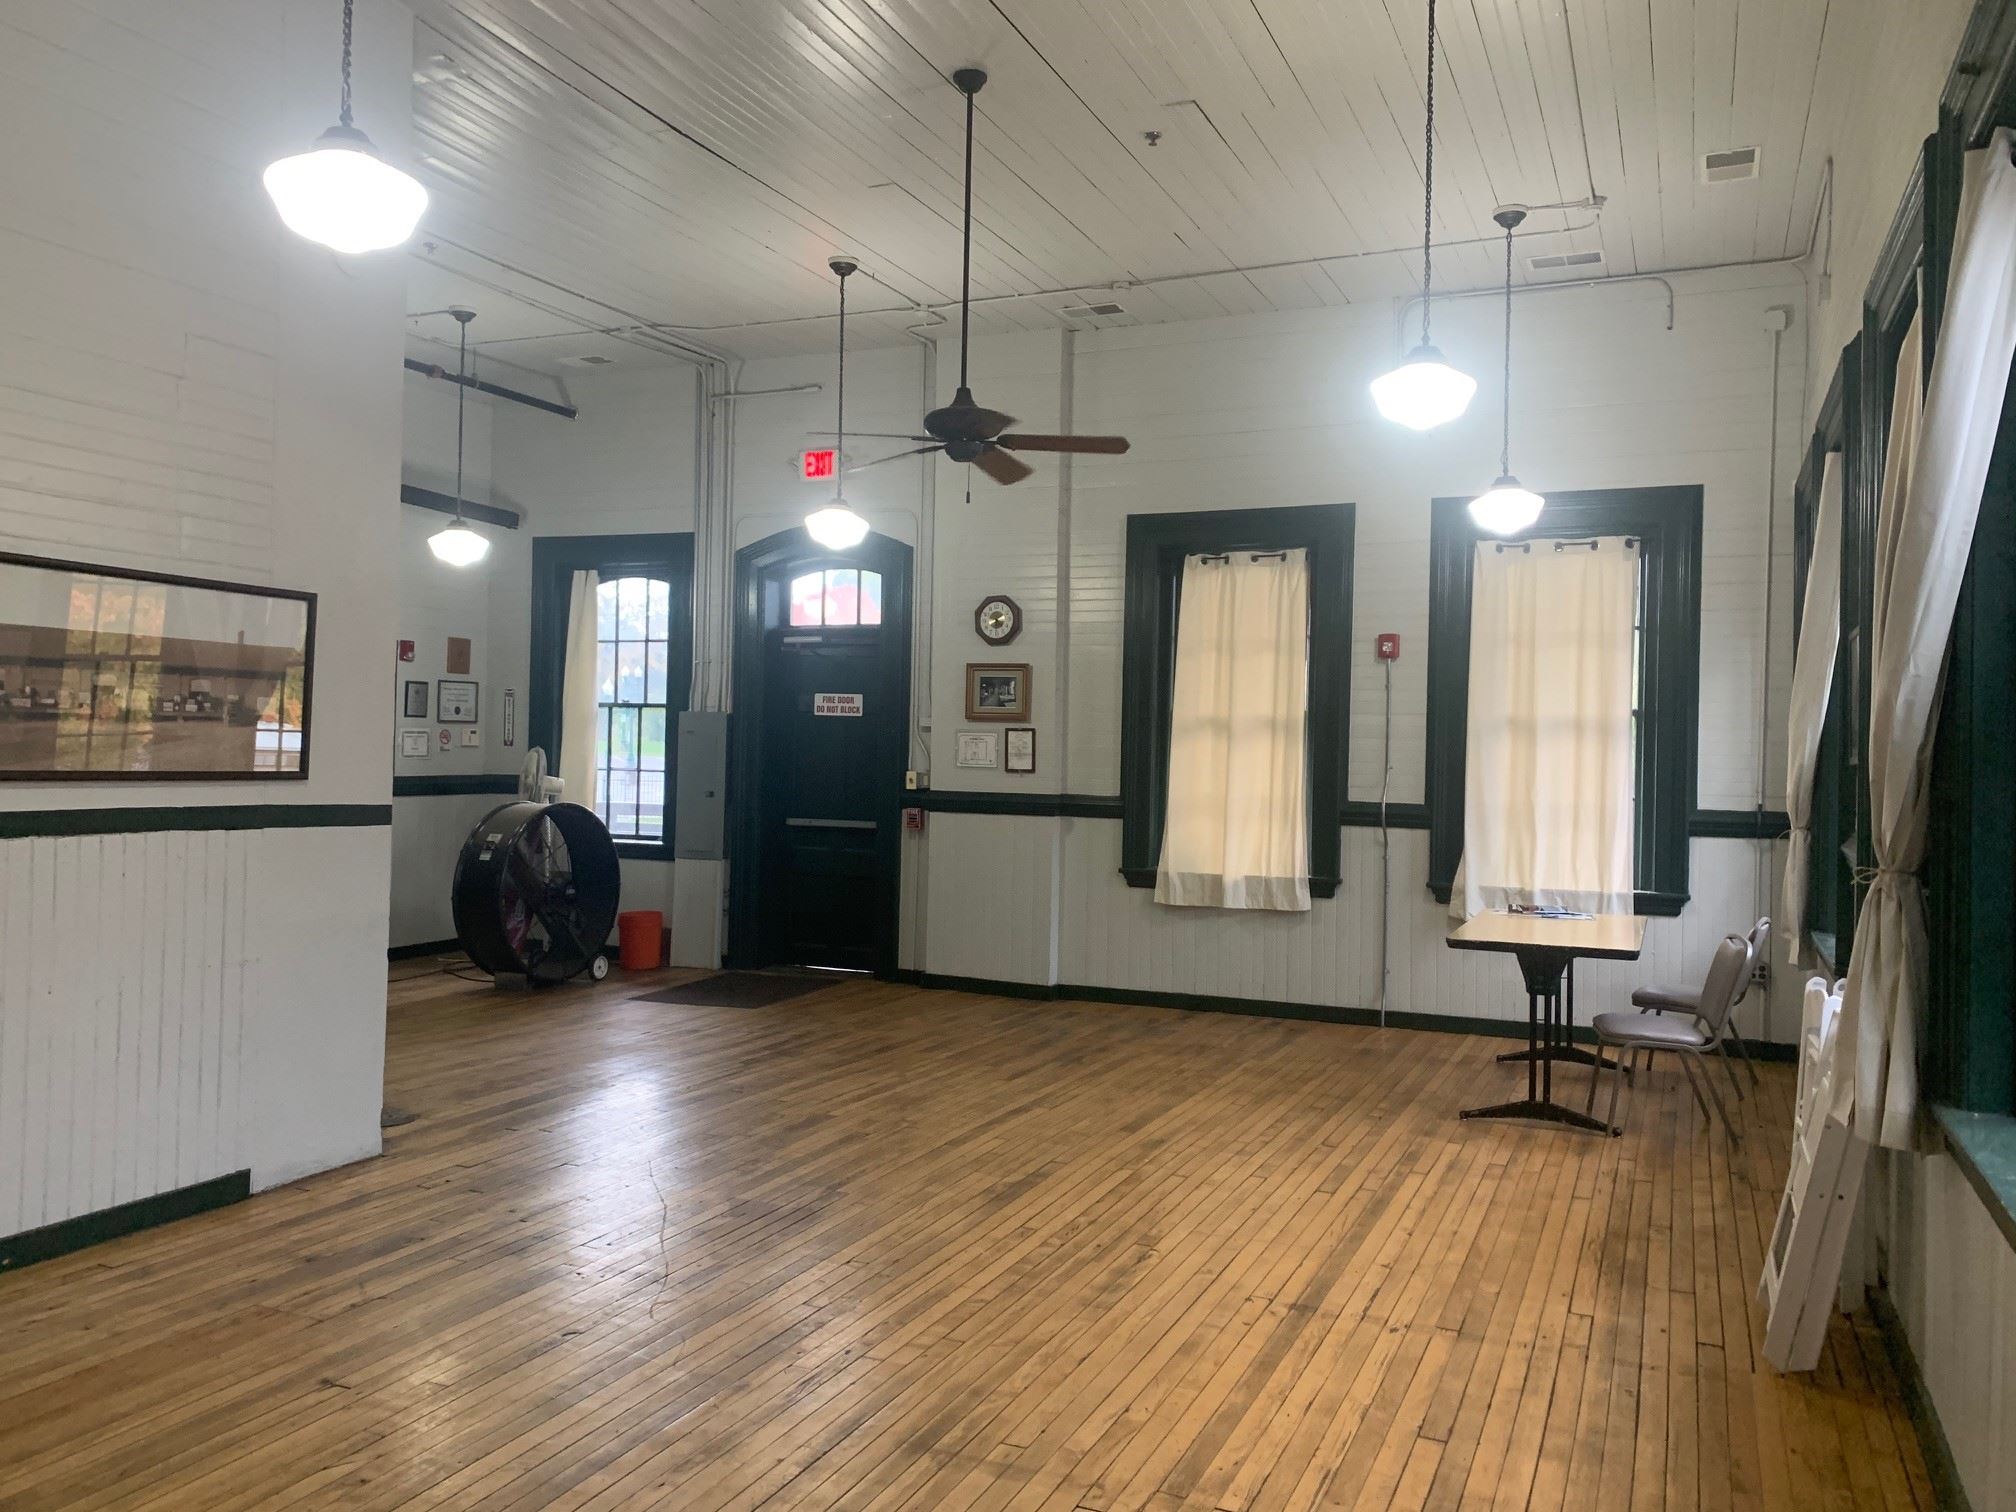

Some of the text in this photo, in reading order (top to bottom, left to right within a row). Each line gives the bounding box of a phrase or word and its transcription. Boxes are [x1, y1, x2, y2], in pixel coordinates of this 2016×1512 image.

[805, 451, 833, 477] EXIT
[838, 696, 855, 704] DOOR
[816, 705, 860, 714] DO NOT BLOCK
